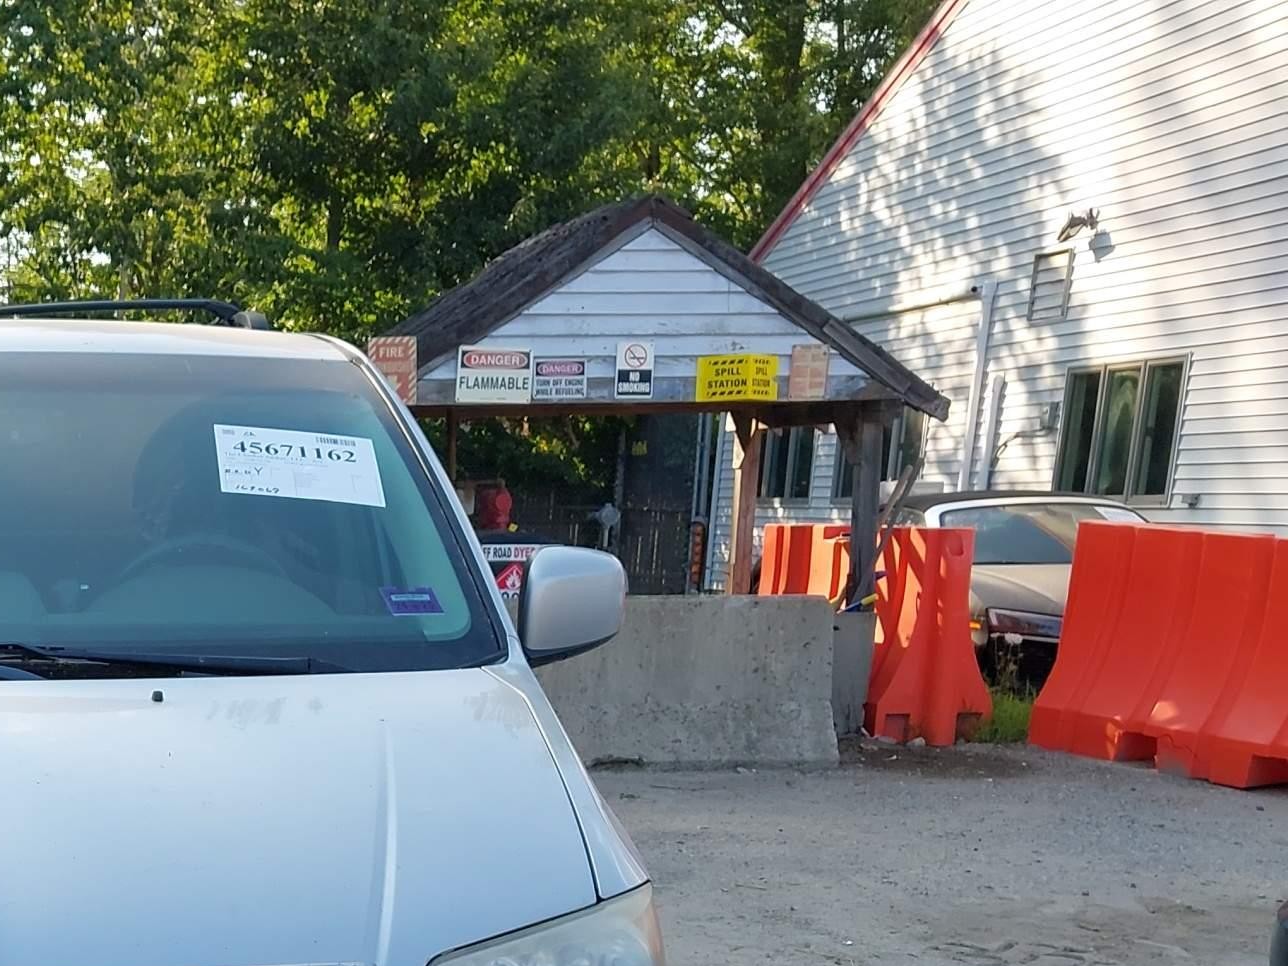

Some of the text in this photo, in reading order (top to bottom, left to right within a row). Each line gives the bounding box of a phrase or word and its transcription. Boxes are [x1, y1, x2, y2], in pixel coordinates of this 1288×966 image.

[379, 347, 403, 358] FIRE
[470, 353, 520, 366] DANGER
[542, 363, 579, 374] DANGER
[714, 367, 741, 376] SPILL
[629, 371, 640, 382] NO
[459, 376, 529, 391] FLAMMABLE
[618, 382, 650, 393] SMOKING
[707, 378, 747, 389] STATION
[232, 440, 357, 463] 45671162
[493, 547, 512, 558] ROAD
